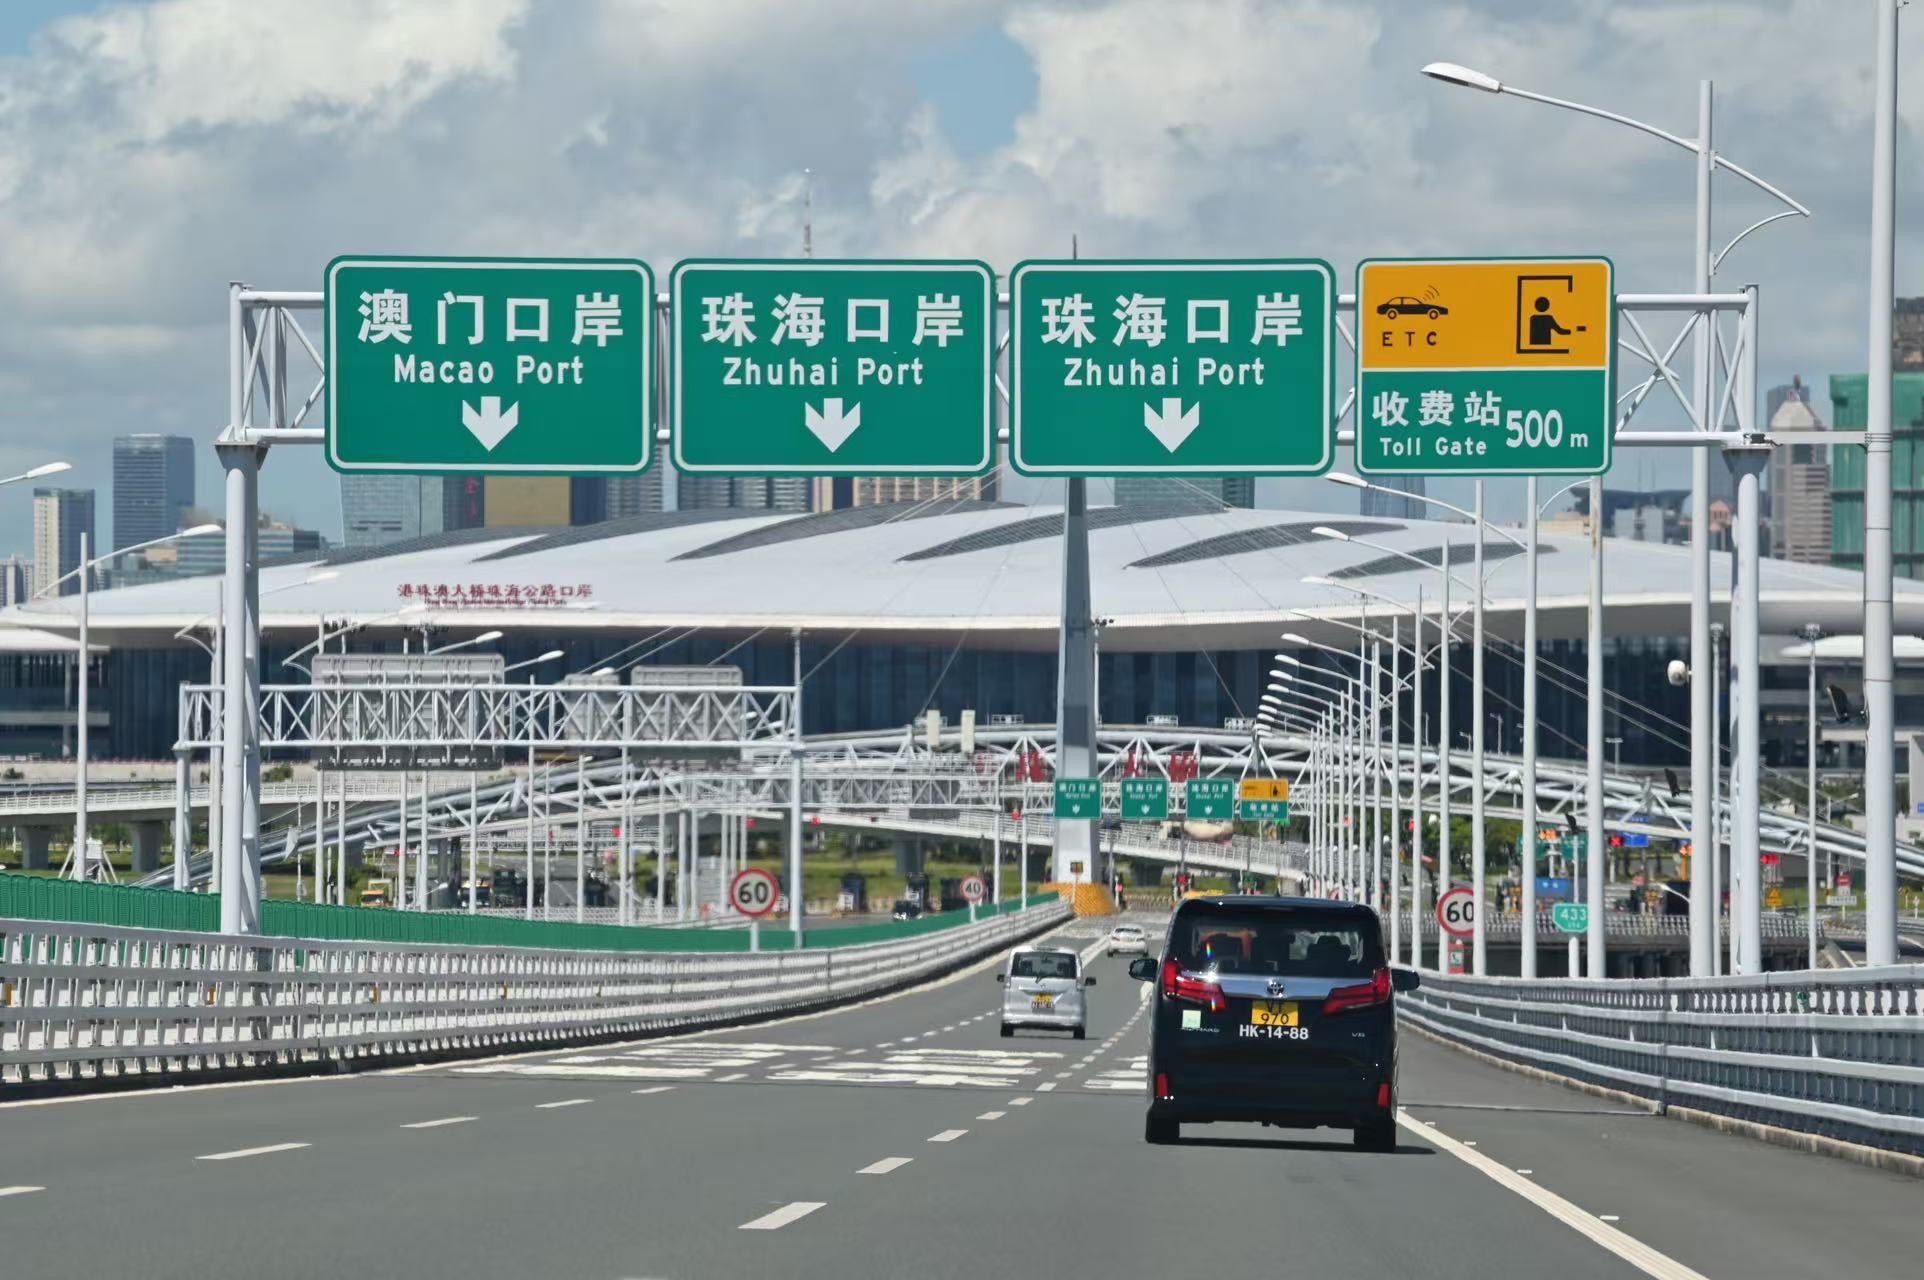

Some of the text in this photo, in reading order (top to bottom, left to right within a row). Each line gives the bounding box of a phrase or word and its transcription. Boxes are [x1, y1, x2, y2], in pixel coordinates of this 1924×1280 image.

[357, 288, 624, 347] 澳门口岸
[701, 292, 964, 348] 珠海口岸
[1041, 292, 1303, 348] 珠海口岸
[1382, 331, 1437, 347] ETC
[394, 353, 584, 385] Macao Port
[723, 356, 924, 386] Zhuhai Port
[1064, 356, 1265, 386] Zhuhai Port
[1371, 390, 1502, 427] 收费站
[1505, 409, 1589, 448] 500 m
[1379, 436, 1487, 456] Toll Gate
[738, 881, 769, 904] 60
[965, 882, 981, 896] 40
[1446, 901, 1474, 923] 60
[1560, 908, 1587, 921] 433
[1239, 1024, 1309, 1040] HK-14-88
[1261, 1013, 1290, 1025] 970
